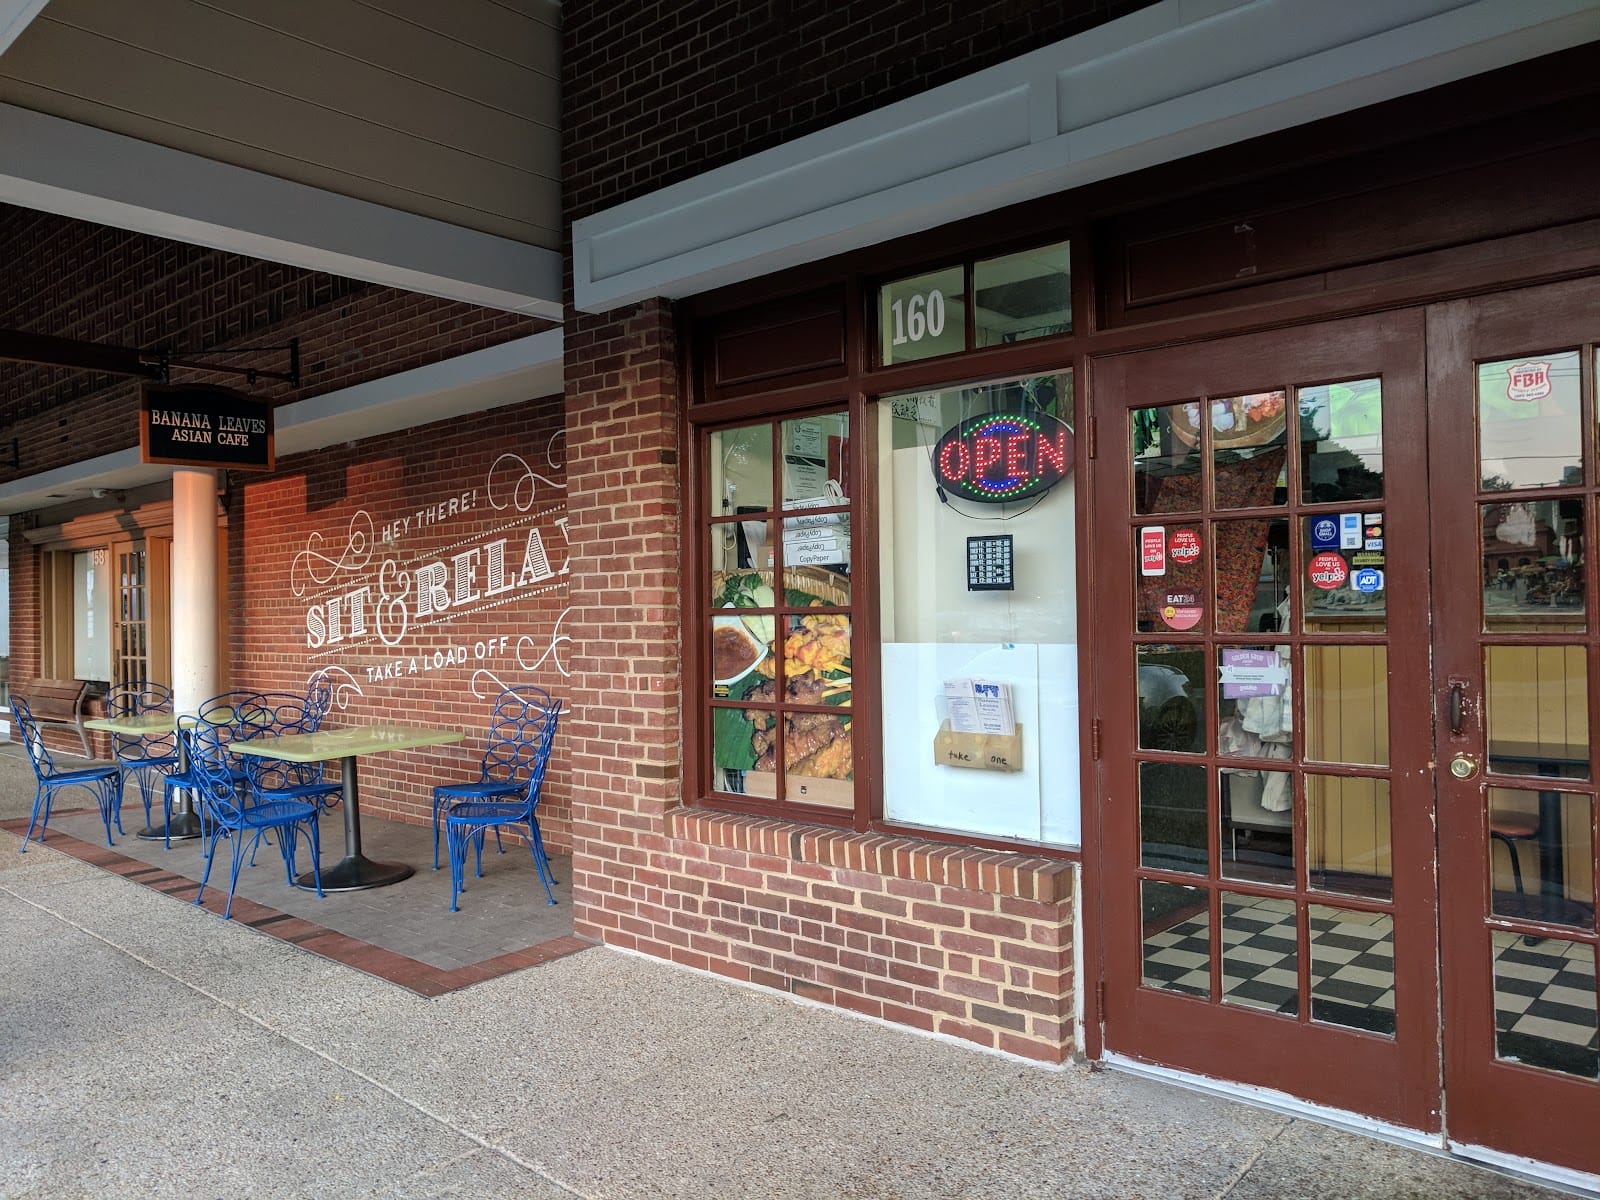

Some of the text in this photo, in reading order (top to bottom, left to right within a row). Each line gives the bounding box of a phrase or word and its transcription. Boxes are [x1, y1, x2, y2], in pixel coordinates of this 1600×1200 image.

[891, 289, 945, 346] 160
[151, 409, 266, 434] BANANA LEAVES
[171, 428, 249, 446] ASIAN CAFE
[940, 431, 1066, 481] OPEN
[382, 489, 478, 543] HEY THERE!
[799, 555, 830, 563] CopyPaper
[1312, 571, 1336, 583] yelp
[1360, 575, 1377, 585] ADT
[306, 585, 372, 649] SIT
[376, 558, 411, 646] &
[366, 635, 509, 683] TAKE A LOAD OFF
[948, 750, 1008, 765] take one
